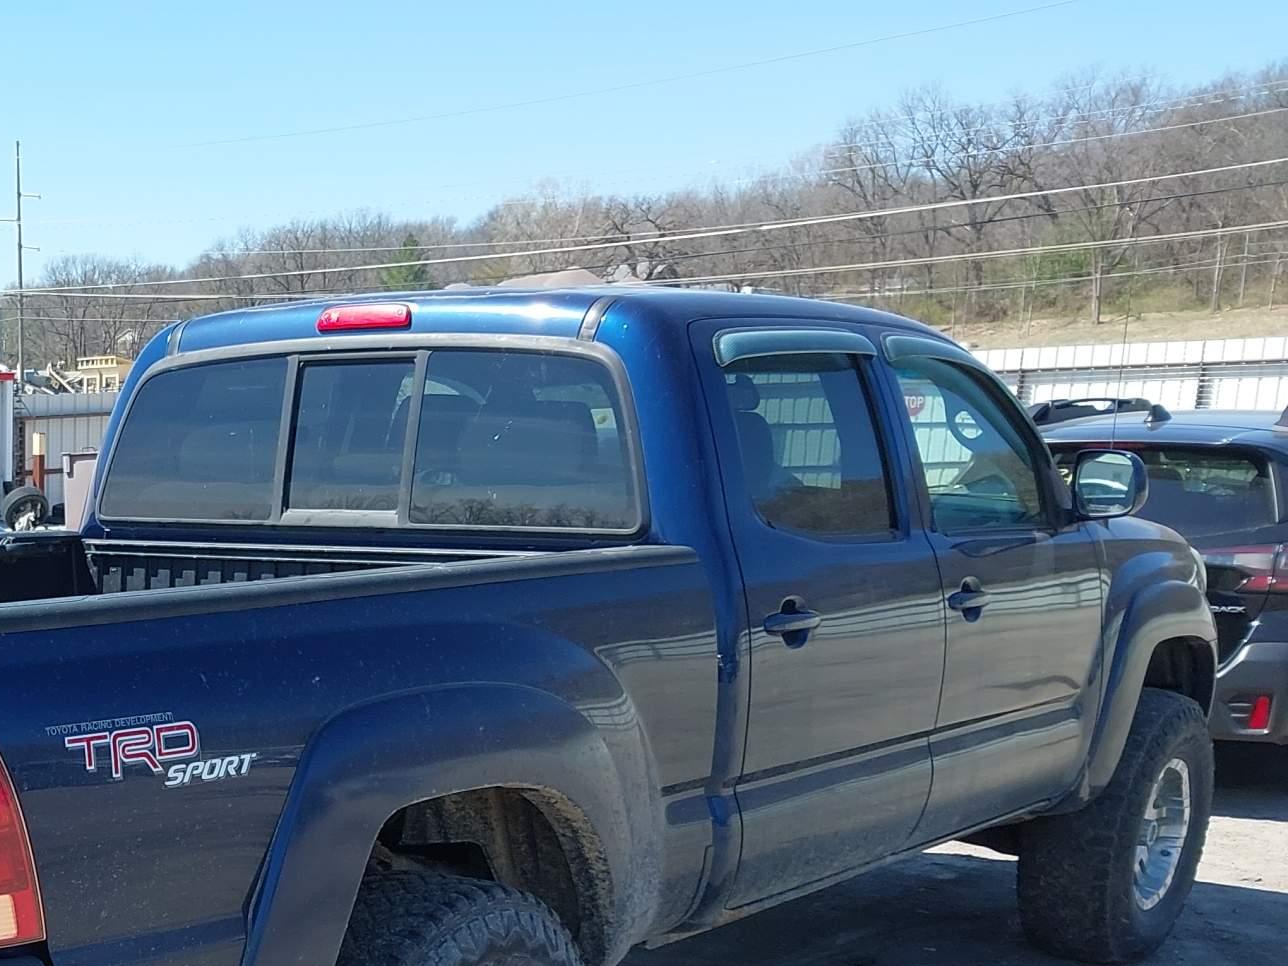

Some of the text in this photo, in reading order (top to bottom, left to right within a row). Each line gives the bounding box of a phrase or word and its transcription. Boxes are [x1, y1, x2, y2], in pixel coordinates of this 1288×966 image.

[904, 394, 925, 409] TOP
[45, 711, 174, 736] TOYOTA RACING DEVELOPMENT
[64, 720, 200, 780] TRD
[164, 752, 257, 787] SPORT
